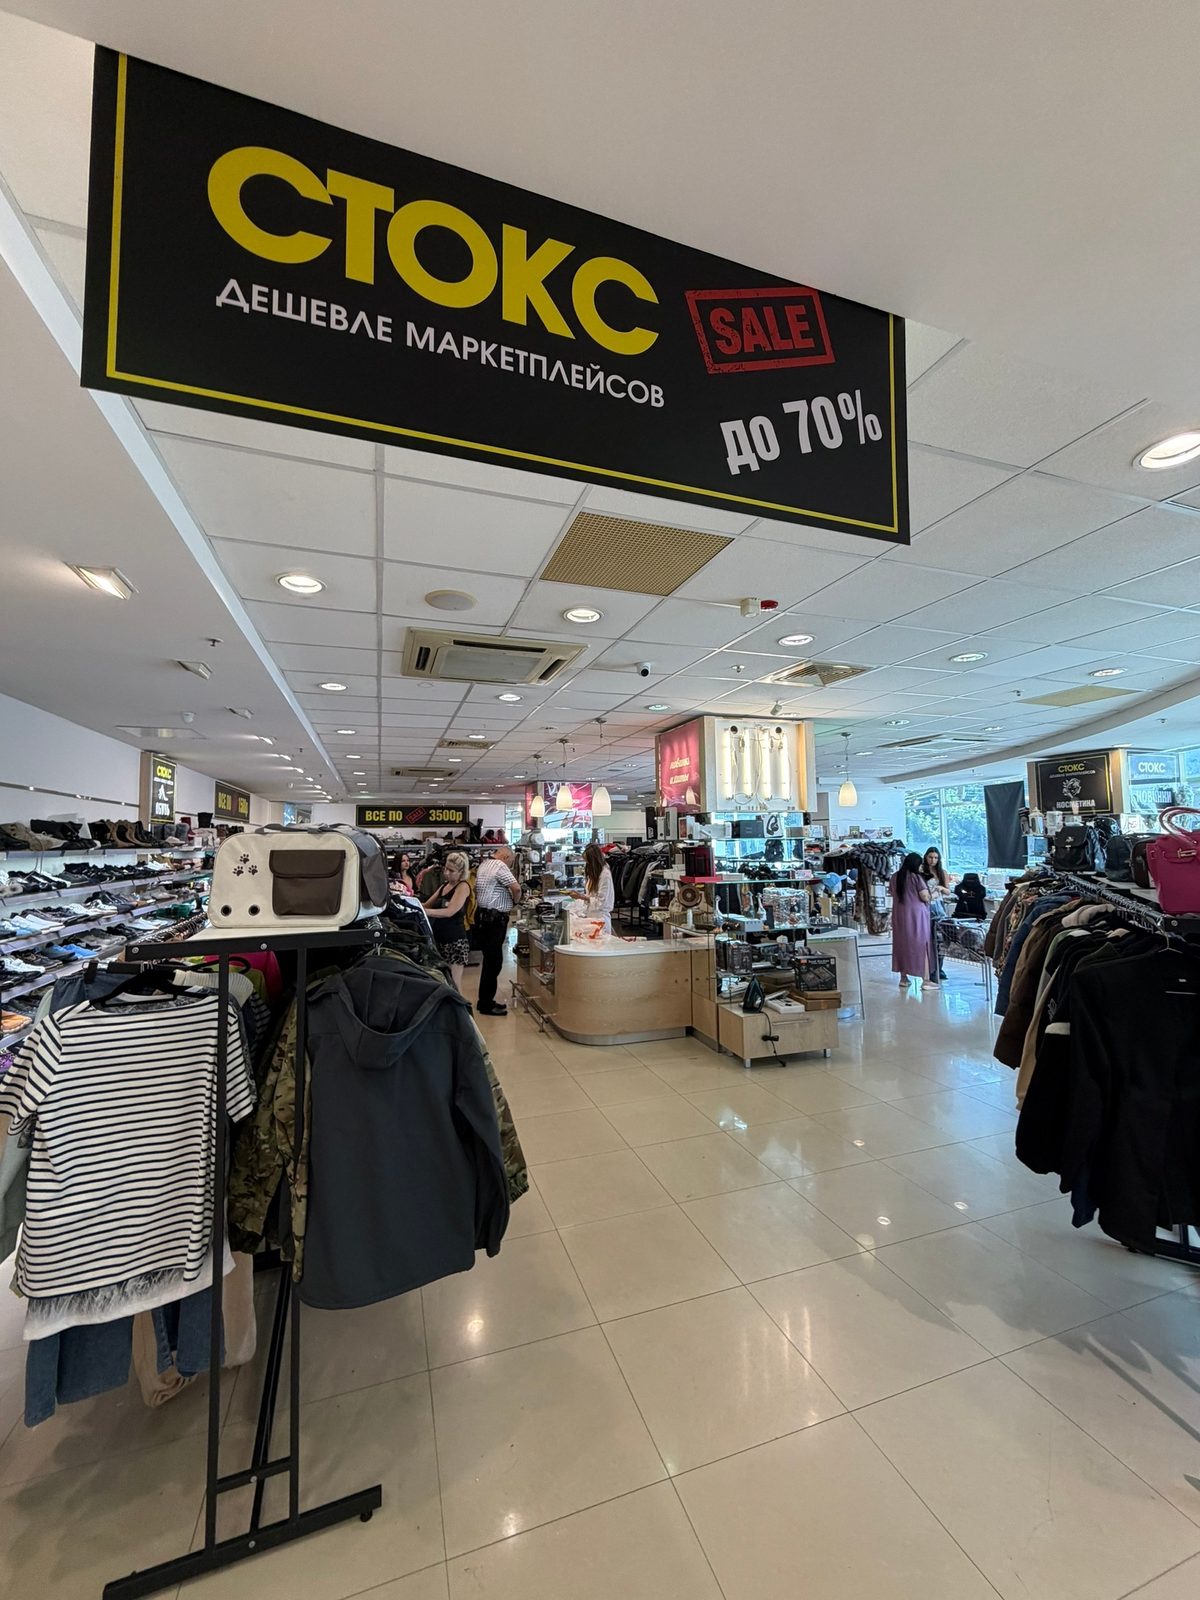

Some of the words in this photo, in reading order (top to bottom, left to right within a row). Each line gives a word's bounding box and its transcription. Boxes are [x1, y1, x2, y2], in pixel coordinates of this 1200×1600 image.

[207, 146, 660, 355] СТОКС
[215, 278, 393, 343] ДЕШЕВЛЕ
[406, 321, 665, 408] МАРКЕТПЛЕЙСОВ
[709, 305, 815, 355] SALE
[720, 415, 780, 475] ДО
[782, 389, 883, 454] 70%
[1058, 763, 1085, 773] СТОКС
[1138, 762, 1165, 773] СТОКС
[365, 810, 386, 821] ВСЕ
[388, 810, 403, 821] ПО
[429, 810, 463, 823] 3500р
